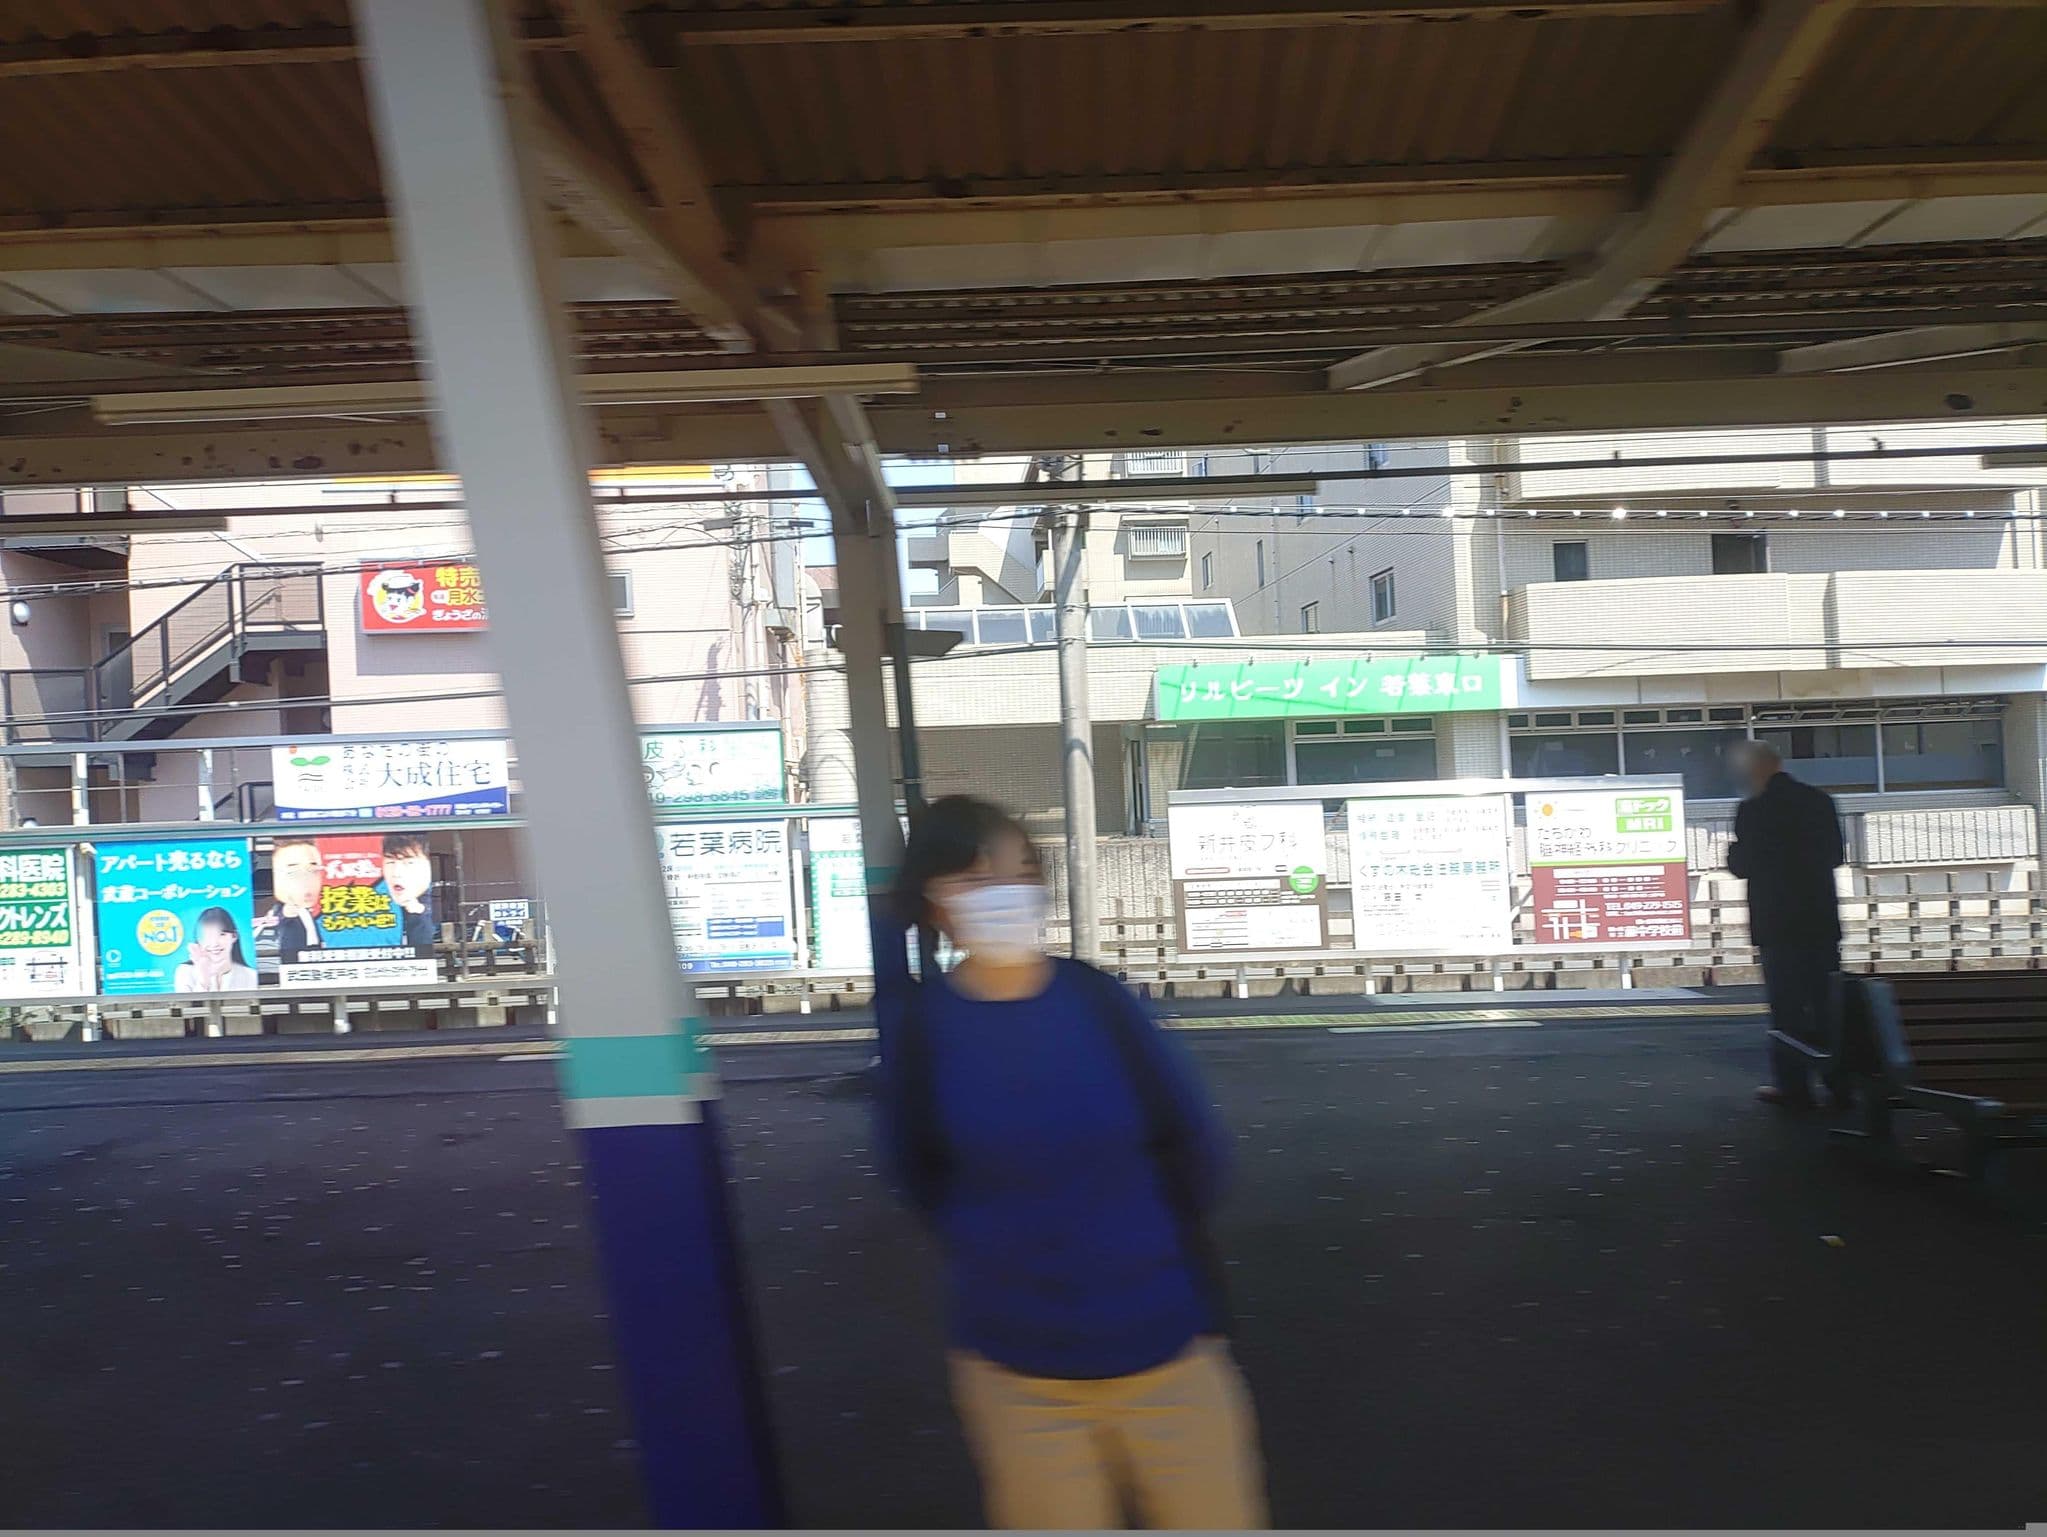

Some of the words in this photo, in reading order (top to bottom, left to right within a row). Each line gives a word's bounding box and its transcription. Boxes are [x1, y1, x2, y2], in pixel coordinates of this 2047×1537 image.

[377, 760, 493, 788] 大成住宅
[670, 829, 781, 857] 若葉病院
[99, 850, 243, 874] アパート売るなら
[320, 885, 391, 914] 授業は
